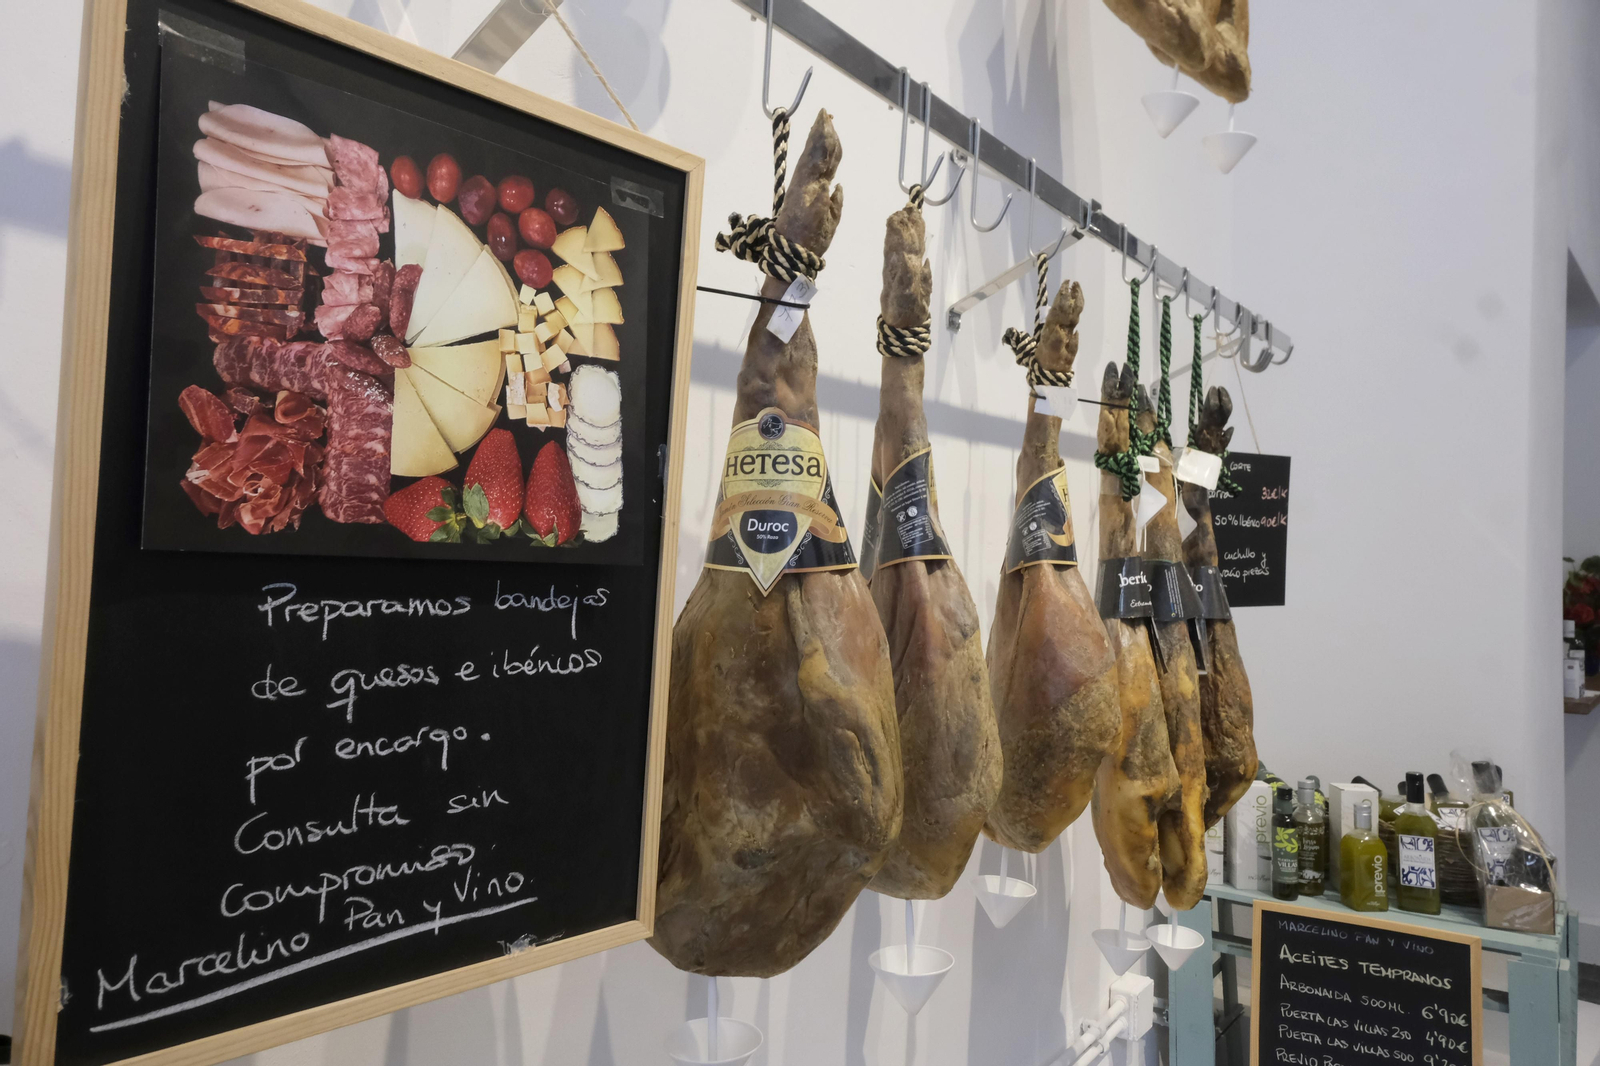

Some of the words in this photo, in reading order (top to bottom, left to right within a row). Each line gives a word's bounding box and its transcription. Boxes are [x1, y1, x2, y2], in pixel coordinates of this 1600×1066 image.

[737, 493, 776, 508] Selección
[778, 493, 801, 508] Gran
[802, 500, 834, 524] Reserva
[747, 518, 790, 532] Duroc
[1215, 513, 1239, 526] 50%
[1260, 551, 1267, 568] y
[258, 582, 471, 641] Preparamos
[494, 580, 610, 640] bandejas
[251, 663, 306, 700] de
[326, 664, 439, 723] quesos
[456, 660, 481, 682] e
[491, 645, 602, 679] ibéricos
[245, 736, 308, 805] por
[335, 726, 490, 771] encargo.
[234, 792, 411, 854] Consulta
[447, 785, 509, 814] sin
[1252, 795, 1270, 843] previo
[1372, 855, 1386, 895] previo
[96, 930, 310, 1010] Marcelino
[344, 897, 405, 930] Pan
[1278, 920, 1348, 940] MARCELINO
[1355, 933, 1380, 946] PAN
[1403, 940, 1434, 955] VINO
[1280, 974, 1352, 1003] ARBONAIDA
[1358, 961, 1452, 990] TEMPRANOS
[1280, 1003, 1325, 1023] PUERTA
[1327, 1016, 1349, 1029] LAS
[1391, 1026, 1412, 1040] 250
[1278, 1024, 1322, 1045] PUERTA
[1327, 1037, 1349, 1049] LAS
[1393, 1050, 1415, 1063] 500
